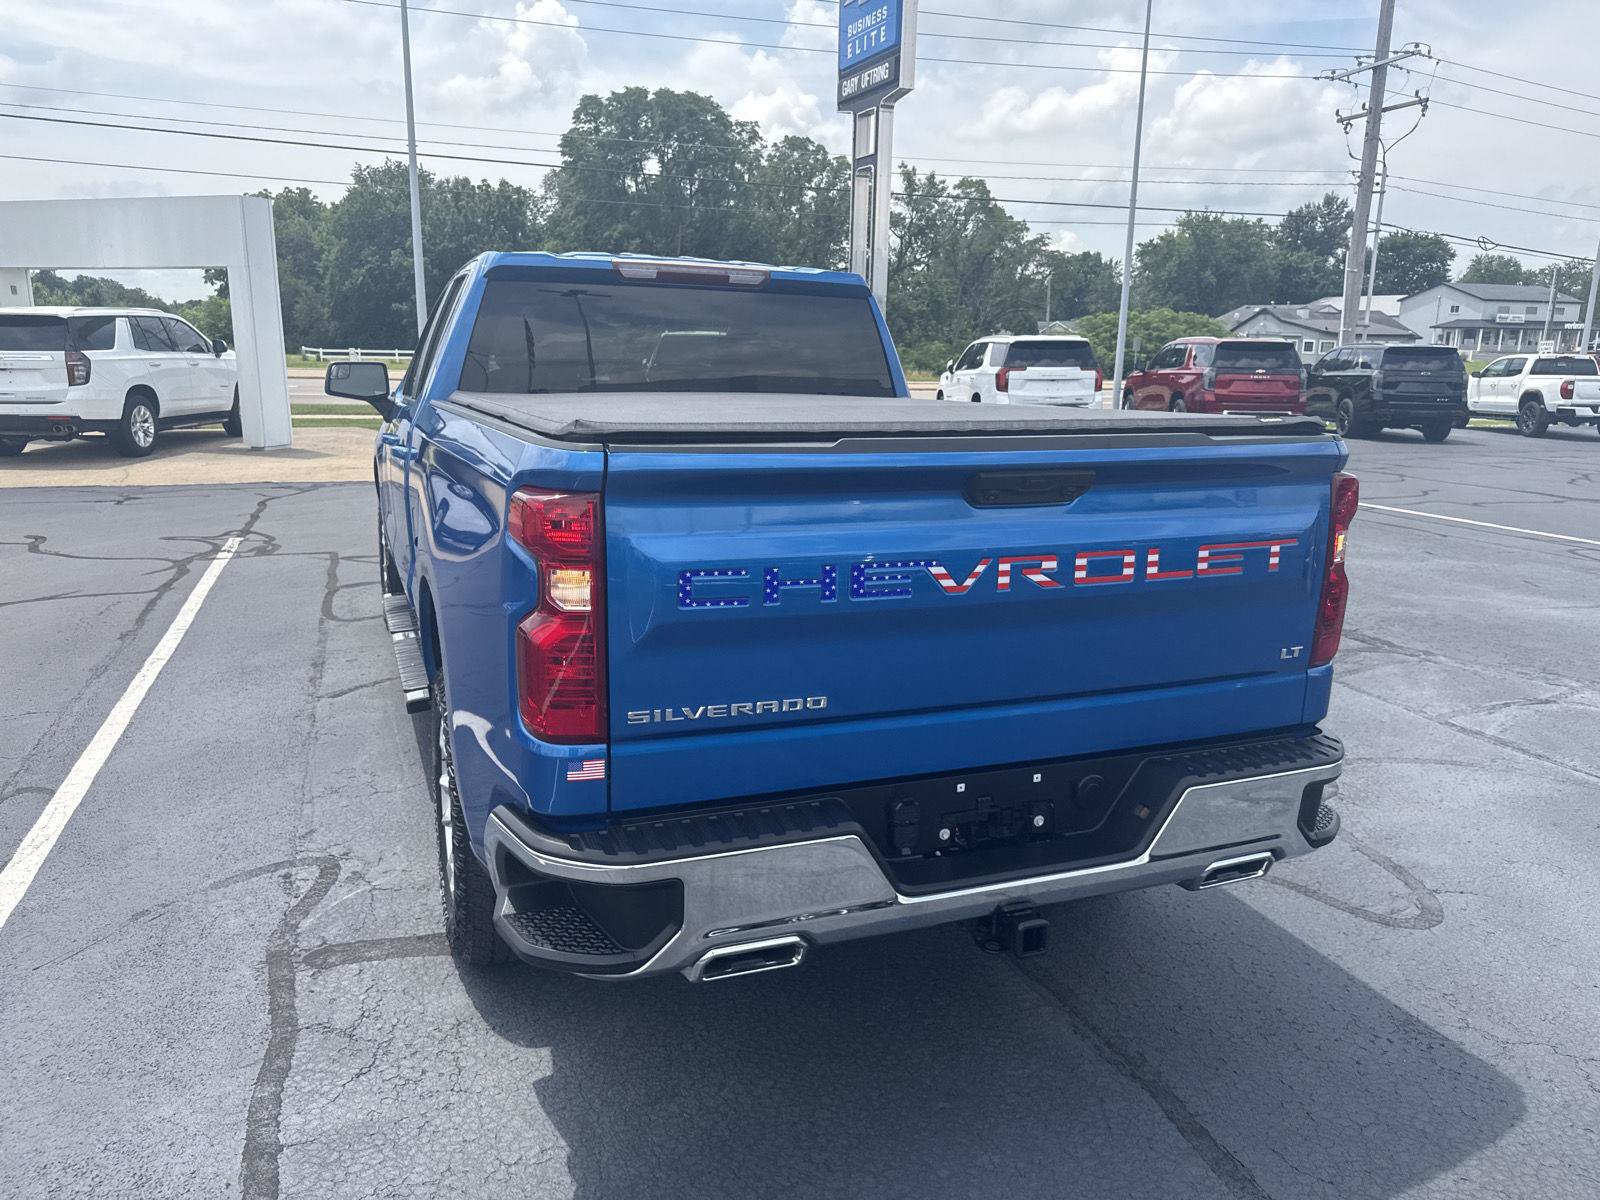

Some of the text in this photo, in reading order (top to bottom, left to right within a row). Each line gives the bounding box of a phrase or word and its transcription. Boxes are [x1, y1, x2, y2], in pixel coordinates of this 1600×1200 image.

[848, 6, 888, 37] BUSINESS
[848, 26, 886, 59] ELITE
[842, 76, 859, 96] GARY
[677, 537, 1298, 610] CHEVROLET
[1280, 646, 1303, 659] LT
[627, 696, 827, 724] SILVERADO
